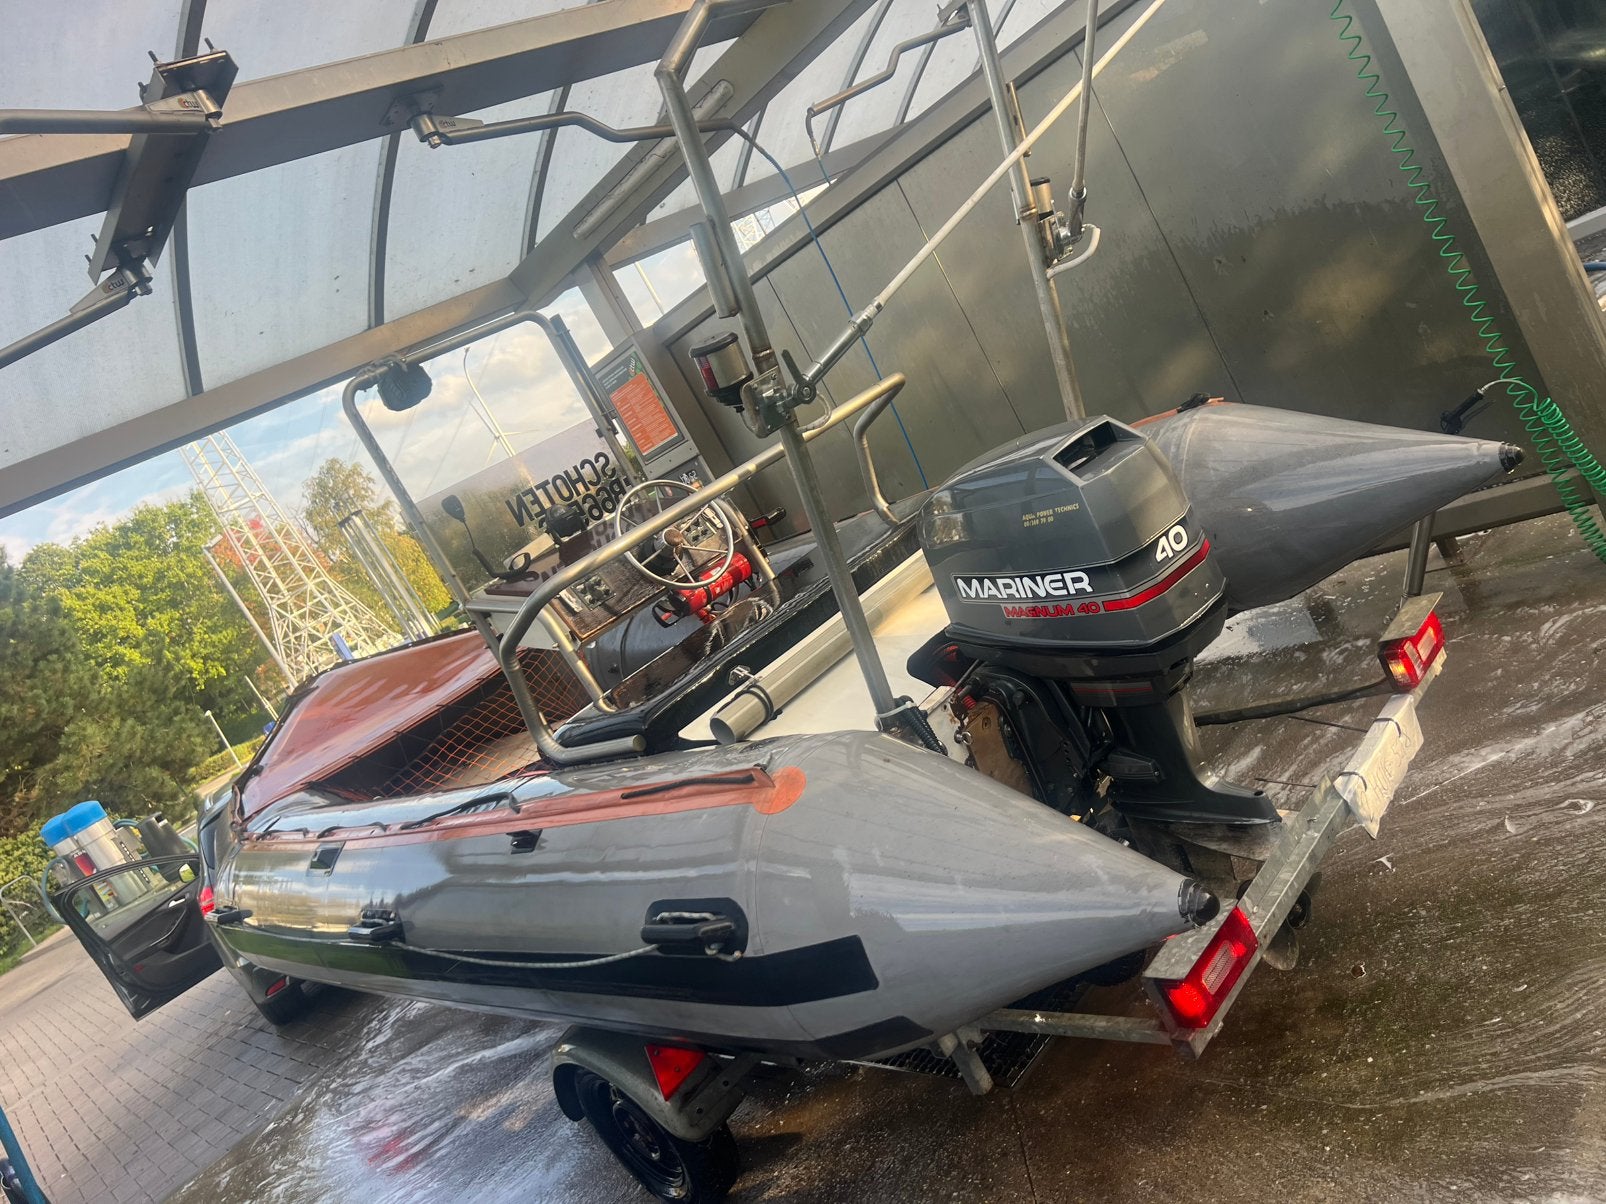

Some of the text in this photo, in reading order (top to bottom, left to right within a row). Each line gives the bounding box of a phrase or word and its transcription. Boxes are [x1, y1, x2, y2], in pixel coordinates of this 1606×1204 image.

[1036, 509, 1053, 517] POWER
[1055, 503, 1079, 513] TECHNICS
[1155, 524, 1188, 562] 40
[956, 571, 1093, 599] MARINER
[1003, 601, 1100, 618] MAGNUM 40
